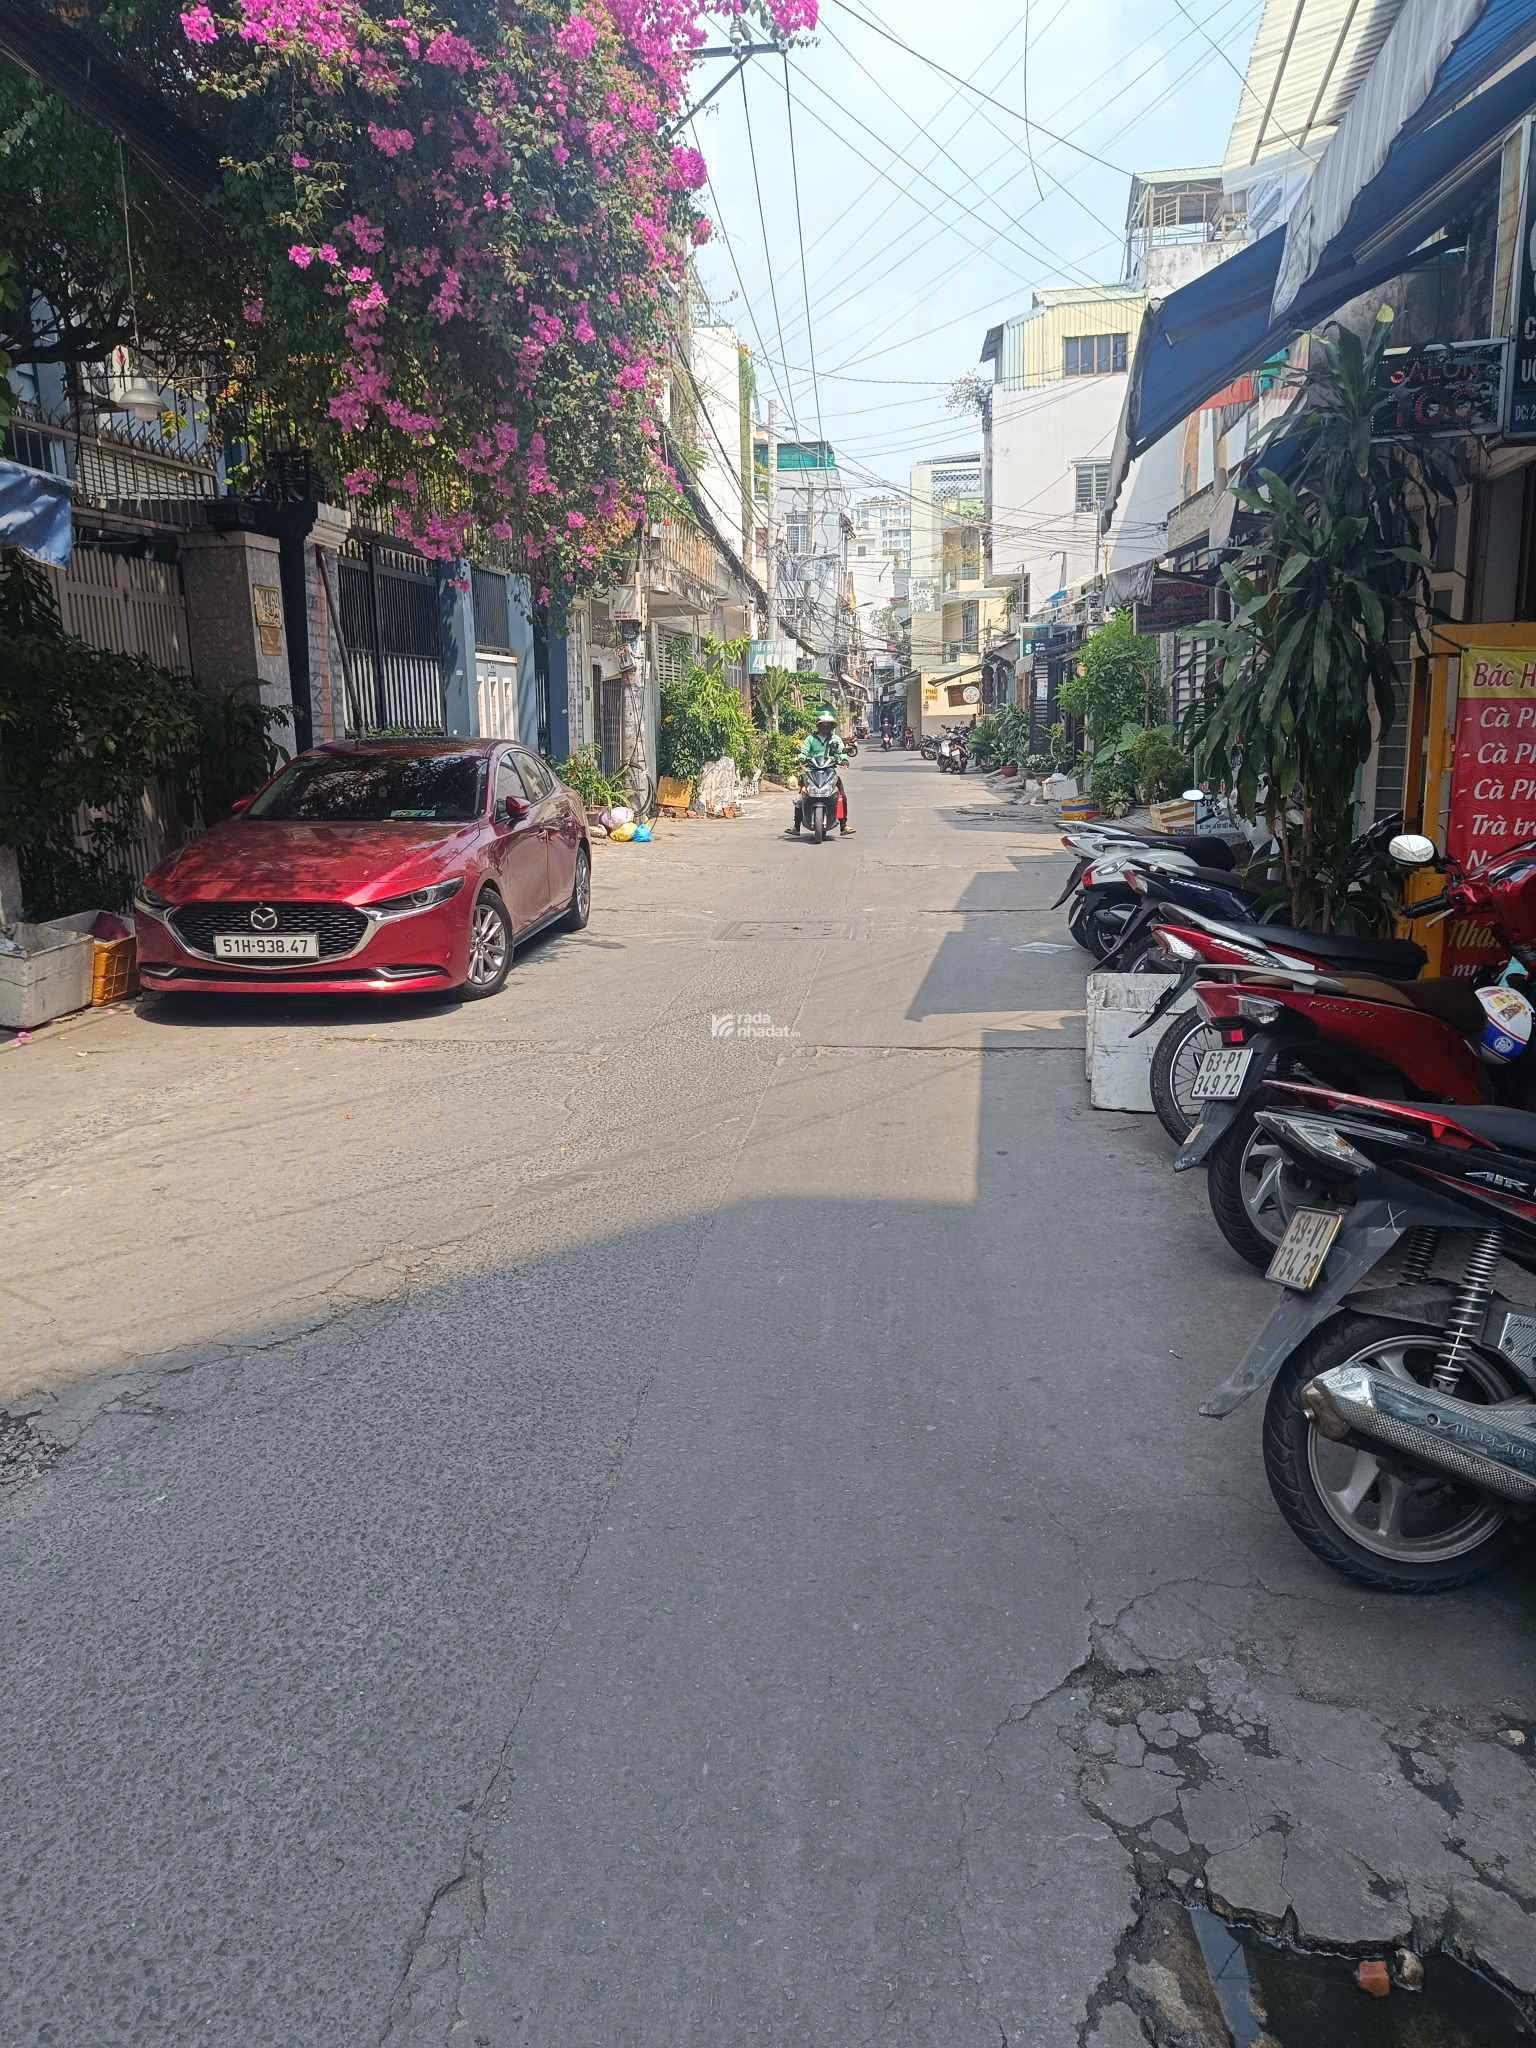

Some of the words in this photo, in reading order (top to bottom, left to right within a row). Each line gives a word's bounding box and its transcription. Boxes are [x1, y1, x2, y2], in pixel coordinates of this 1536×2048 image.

[1473, 662, 1514, 687] Bác
[1480, 706, 1511, 728] Cà
[1477, 742, 1508, 764] Cà
[1474, 778, 1504, 800] Cà
[1472, 814, 1507, 835] Trà
[223, 939, 308, 953] 51H-938.47
[1194, 1074, 1240, 1095] 349.72
